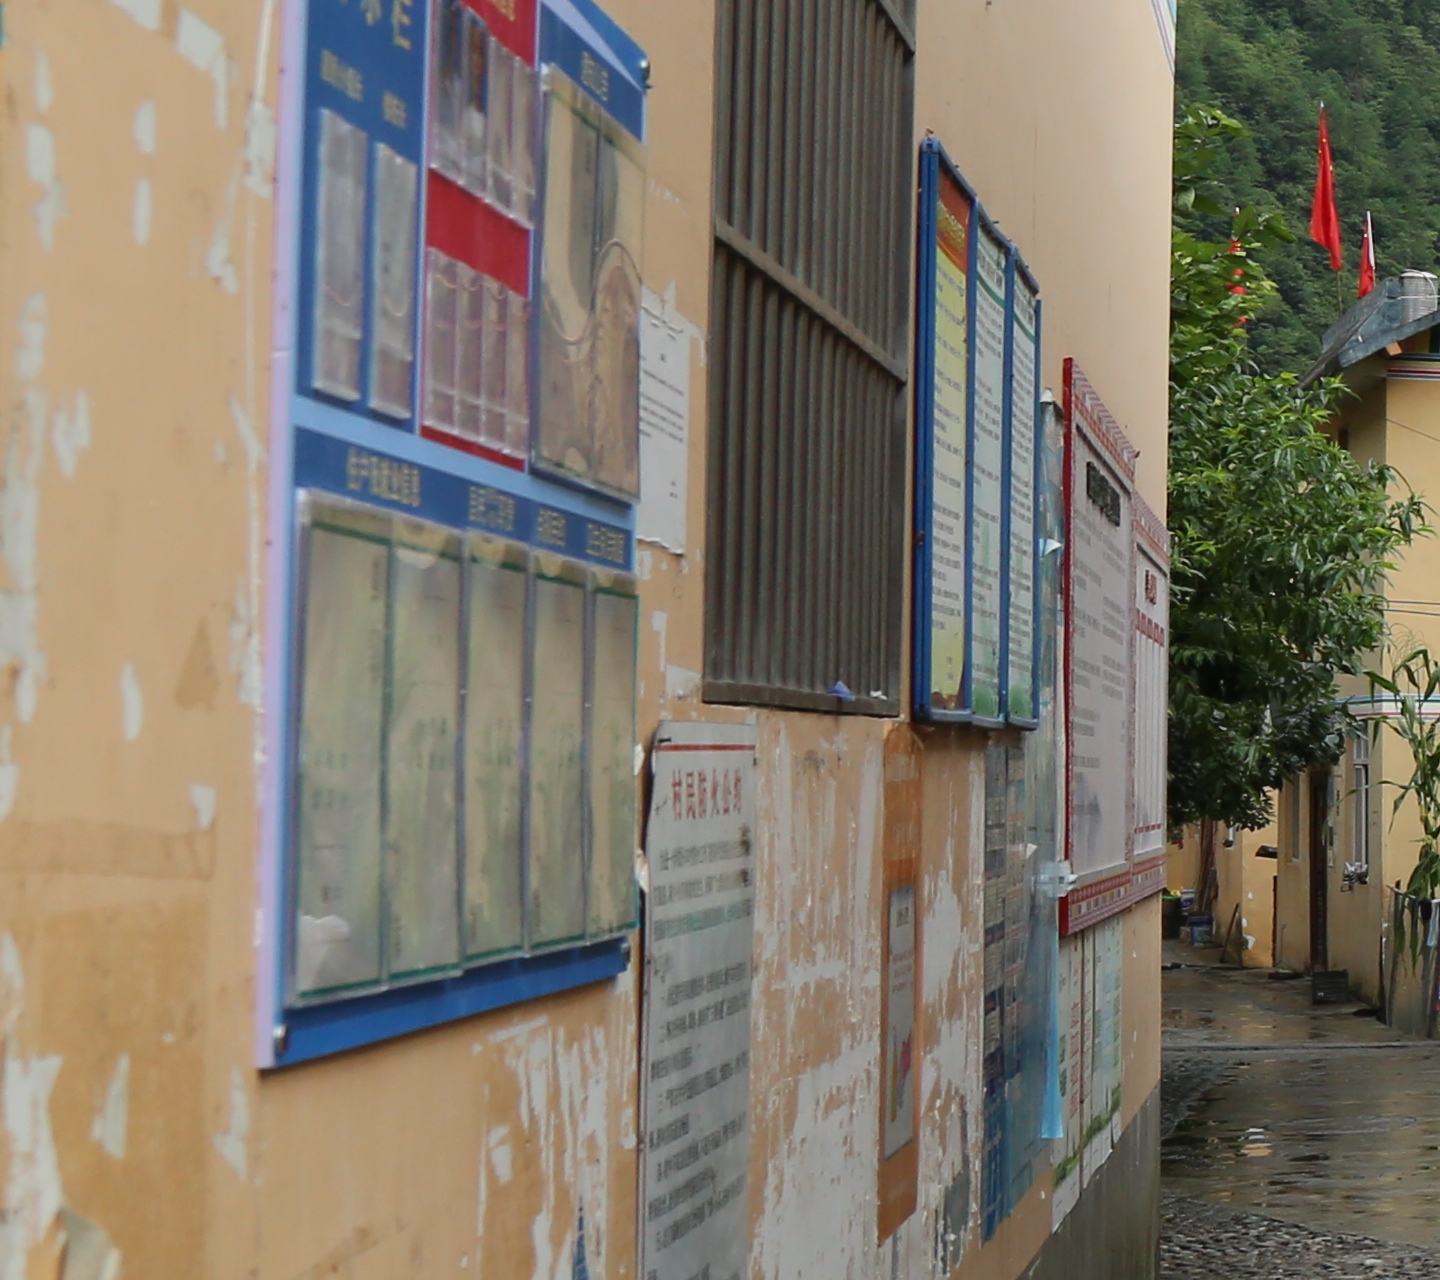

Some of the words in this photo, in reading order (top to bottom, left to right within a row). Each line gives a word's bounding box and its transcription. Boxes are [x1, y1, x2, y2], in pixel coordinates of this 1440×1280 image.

[671, 769, 742, 821] 村民防火公约
